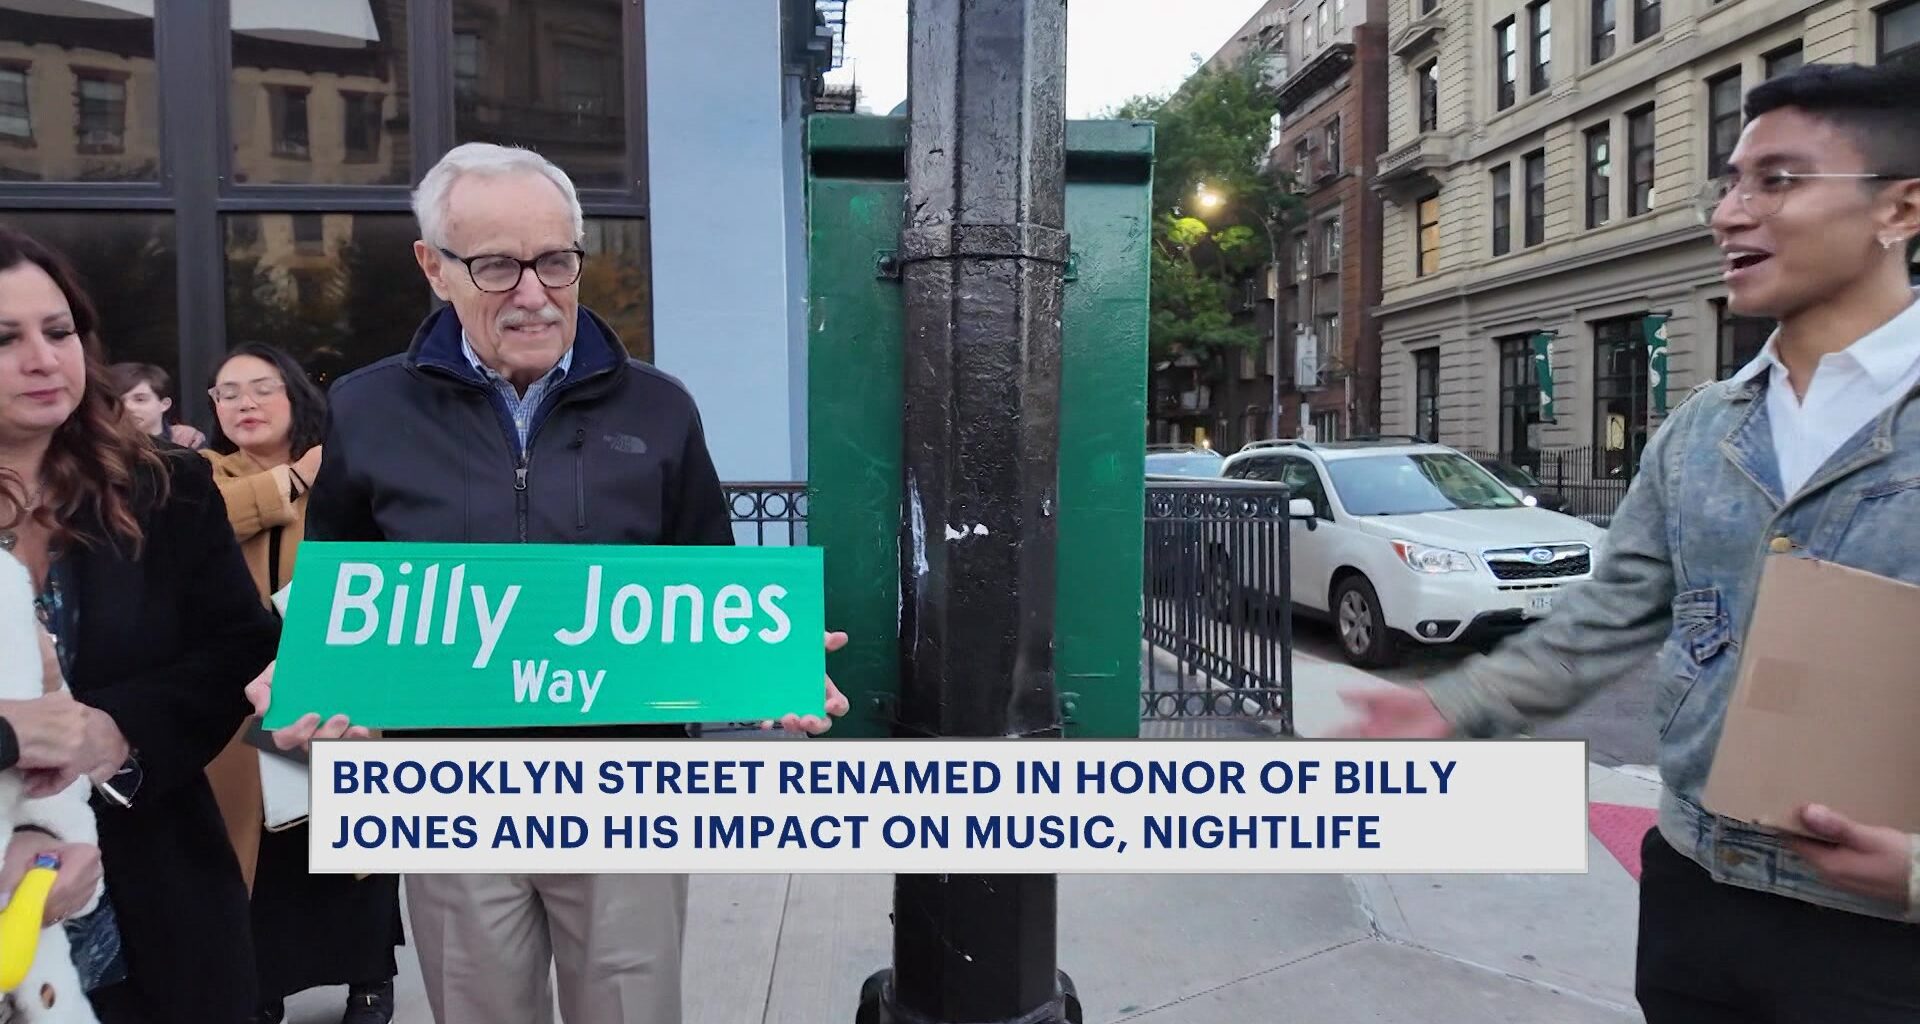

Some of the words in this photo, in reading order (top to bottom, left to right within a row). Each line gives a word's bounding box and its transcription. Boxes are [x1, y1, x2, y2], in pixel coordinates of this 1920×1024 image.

[325, 562, 521, 669] Billy
[554, 564, 791, 645] Jones
[512, 659, 606, 713] Way
